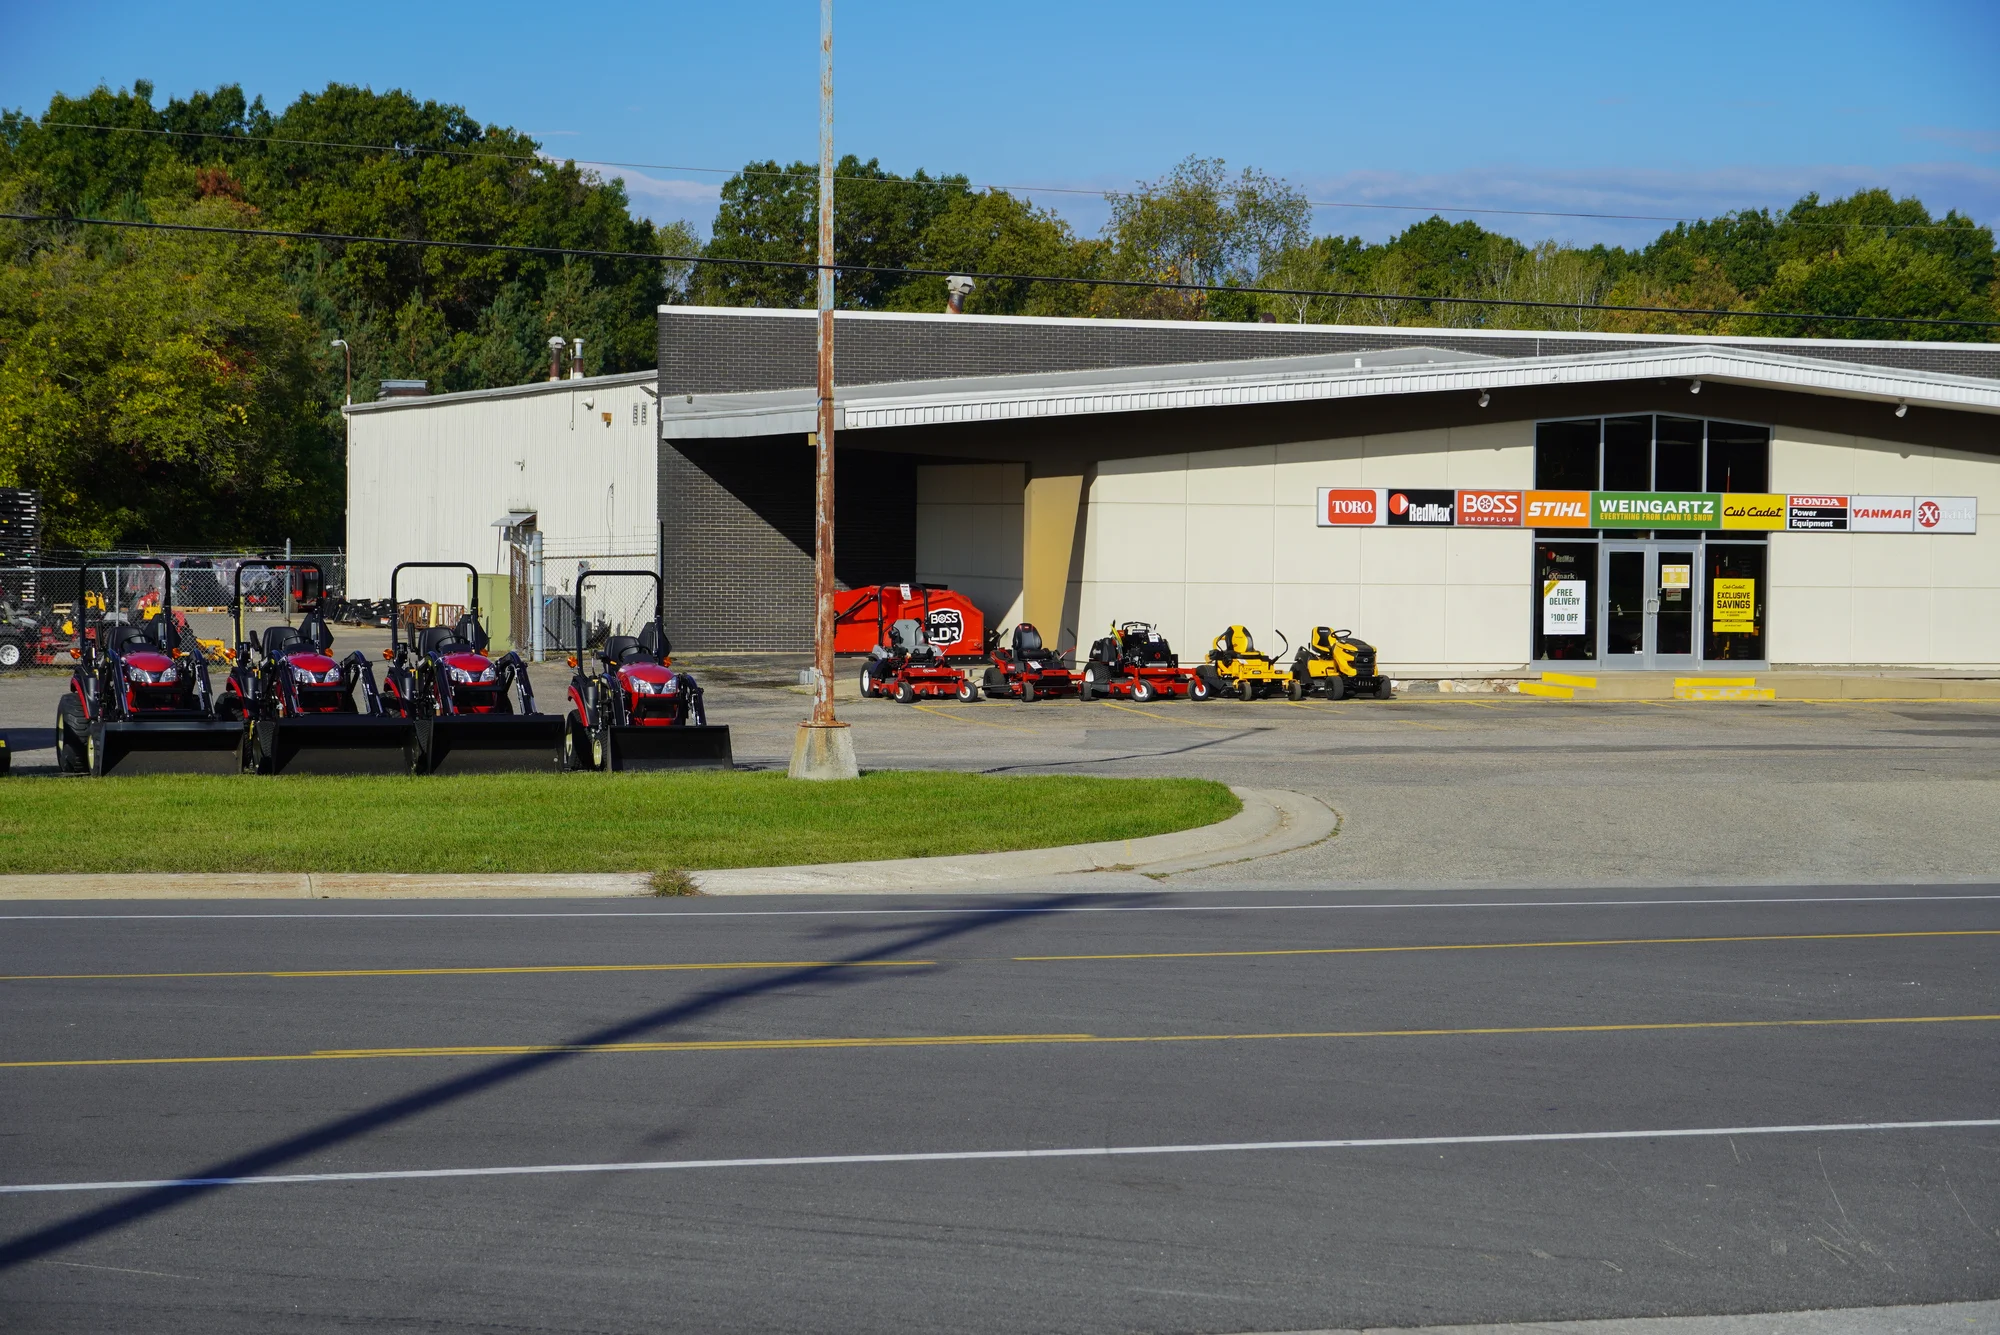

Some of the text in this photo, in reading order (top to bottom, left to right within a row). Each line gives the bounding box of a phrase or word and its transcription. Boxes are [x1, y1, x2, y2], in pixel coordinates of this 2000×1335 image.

[1332, 500, 1373, 514] TORO
[1464, 494, 1517, 514] BOSS
[1599, 499, 1714, 514] WEINGARTZ
[1792, 497, 1840, 506] HONDA
[1408, 503, 1452, 522] RedMax
[1527, 501, 1587, 517] STIHL
[1723, 505, 1784, 517] Cub Cadet
[1792, 508, 1817, 518] Power
[1852, 508, 1912, 519] YANMAR
[1642, 513, 1661, 521] FROM
[1663, 513, 1682, 521] LAWN
[1693, 514, 1713, 522] SNOW
[1792, 519, 1834, 529] Equipment
[1549, 597, 1580, 605] DELIVERY
[1716, 600, 1750, 609] SAVINGS
[930, 612, 958, 624] BOSS
[1551, 613, 1578, 621] $100 OFF
[930, 627, 960, 641] LDR
